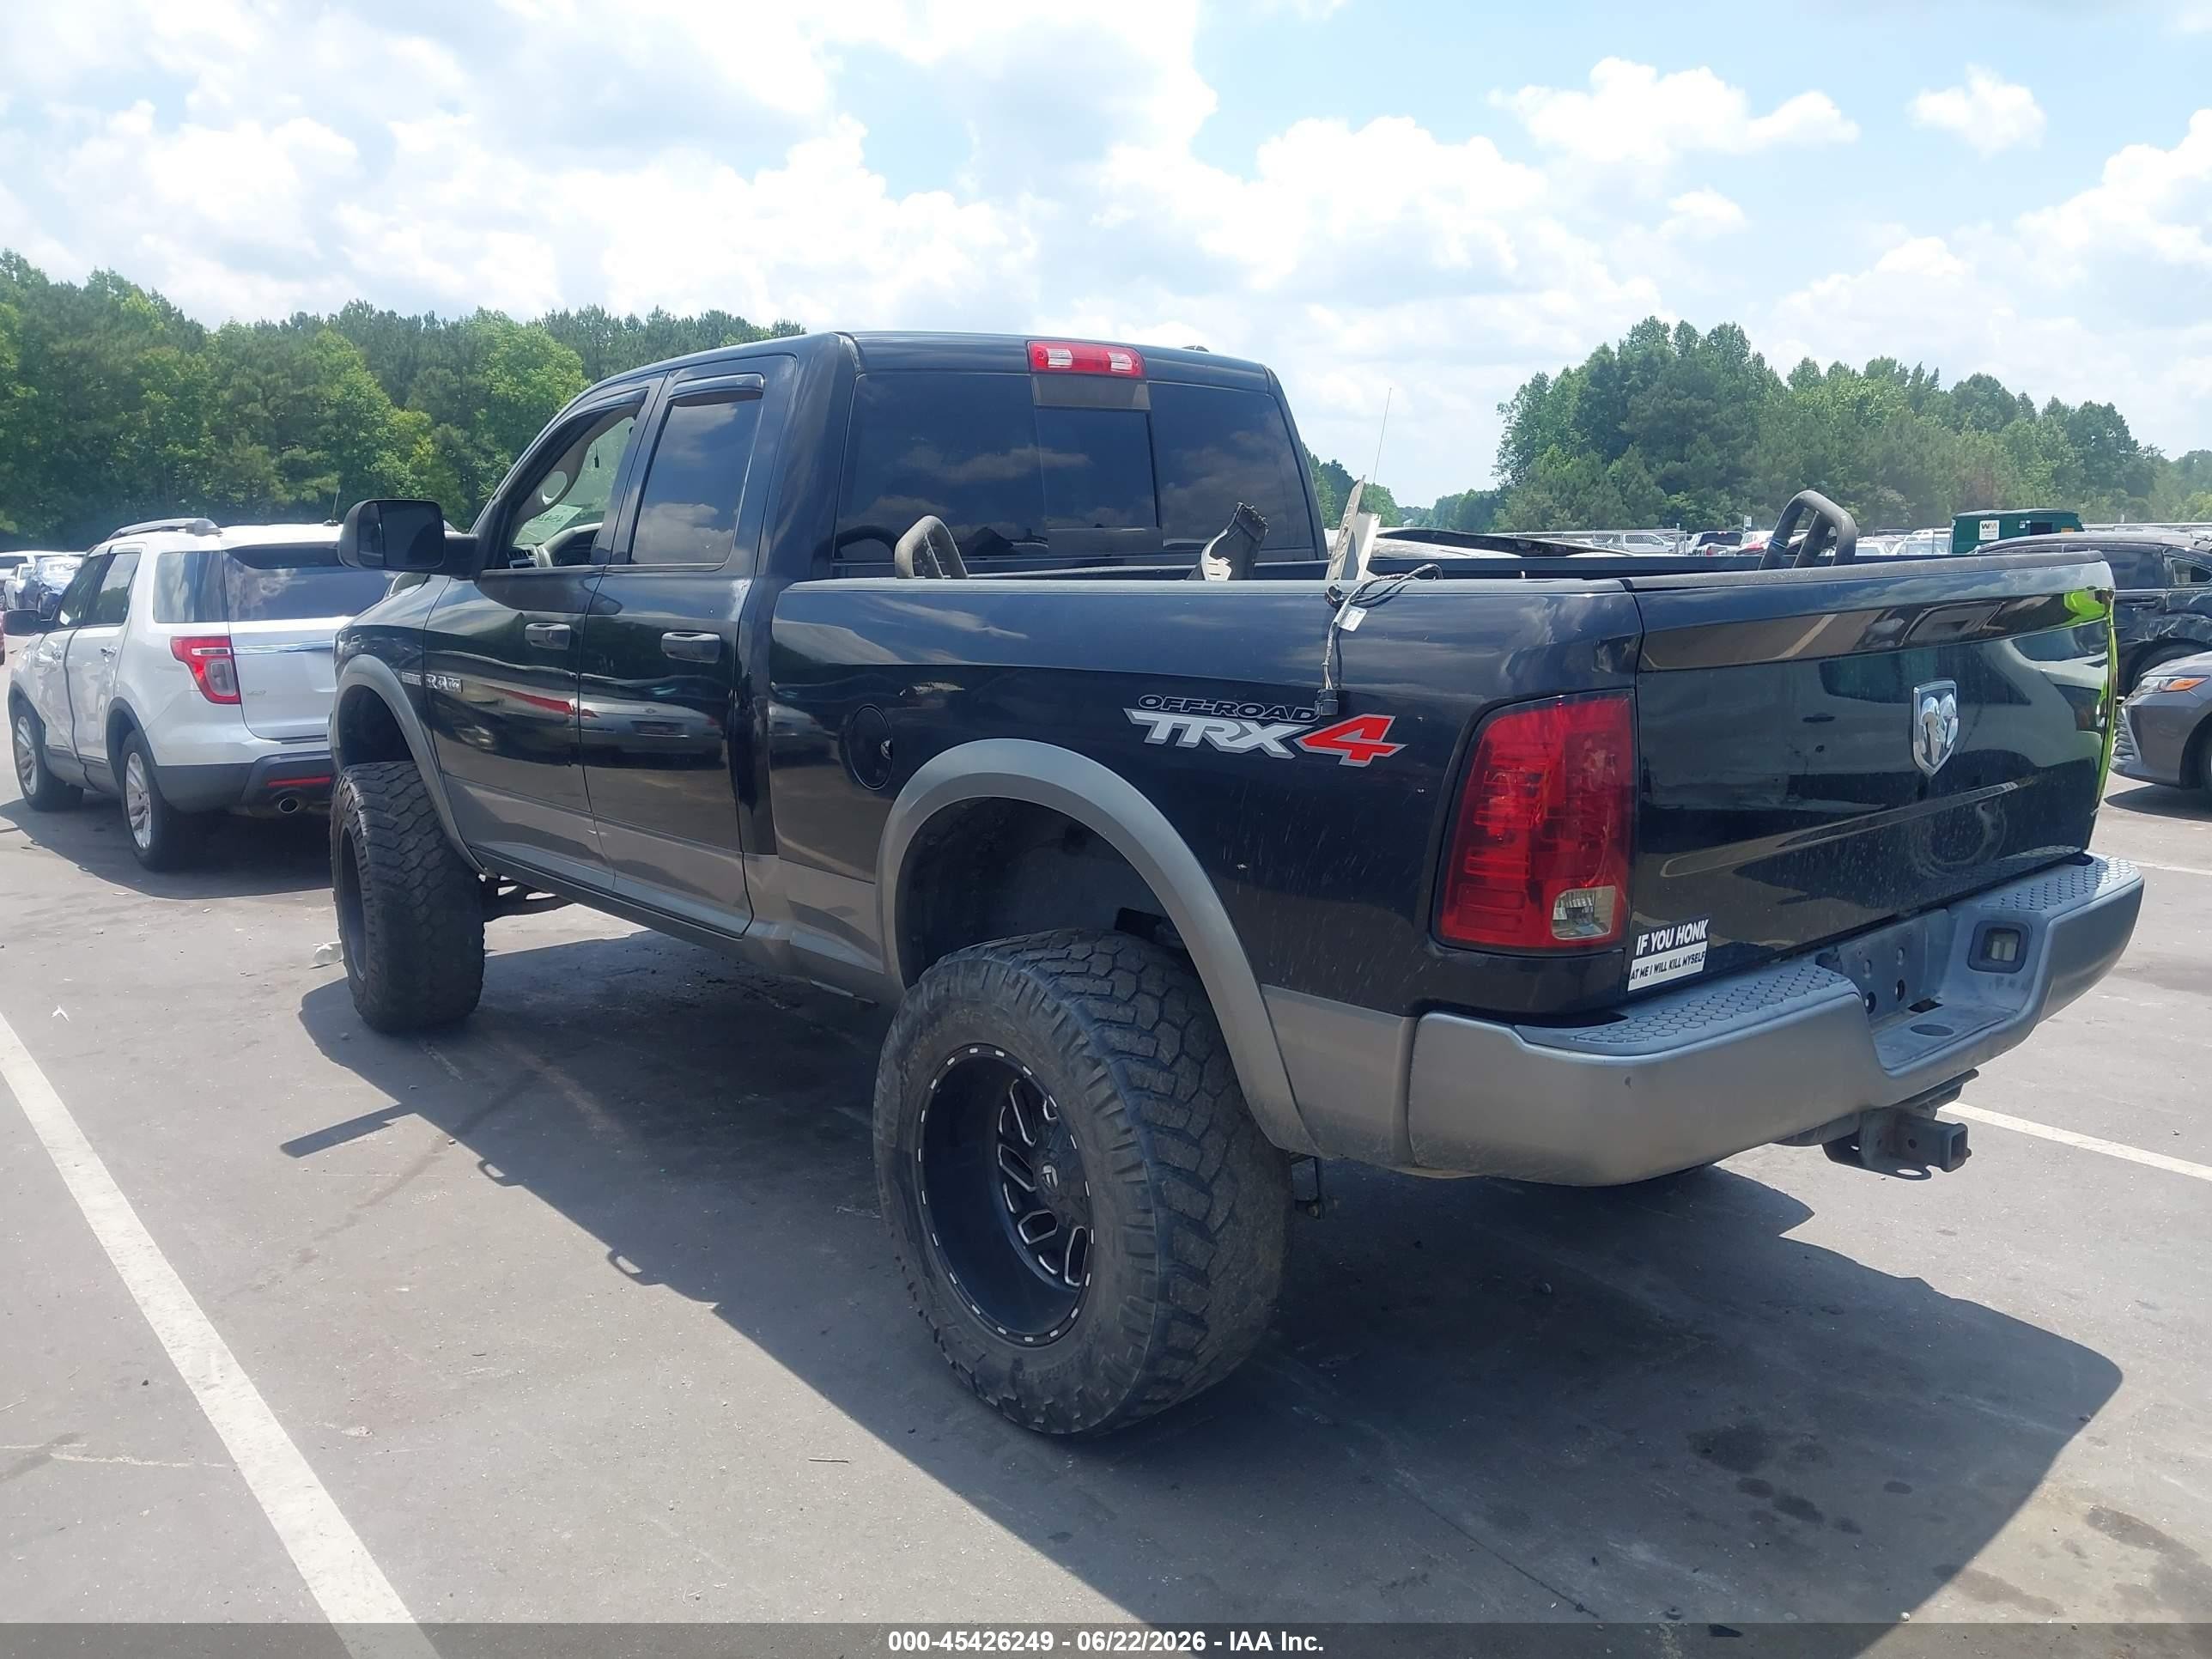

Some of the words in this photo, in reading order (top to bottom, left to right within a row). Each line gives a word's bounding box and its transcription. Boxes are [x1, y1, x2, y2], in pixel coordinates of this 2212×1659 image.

[1138, 695, 1319, 724] OFF-ROAD
[1636, 933, 1649, 956] IF
[1651, 927, 1674, 952] YOU
[1675, 919, 1709, 946] HONK
[1631, 969, 1639, 980] AT
[1640, 965, 1649, 977] ME
[1654, 961, 1668, 974] WILL
[1668, 957, 1680, 970] KILL
[1682, 951, 1705, 966] MYSELF
